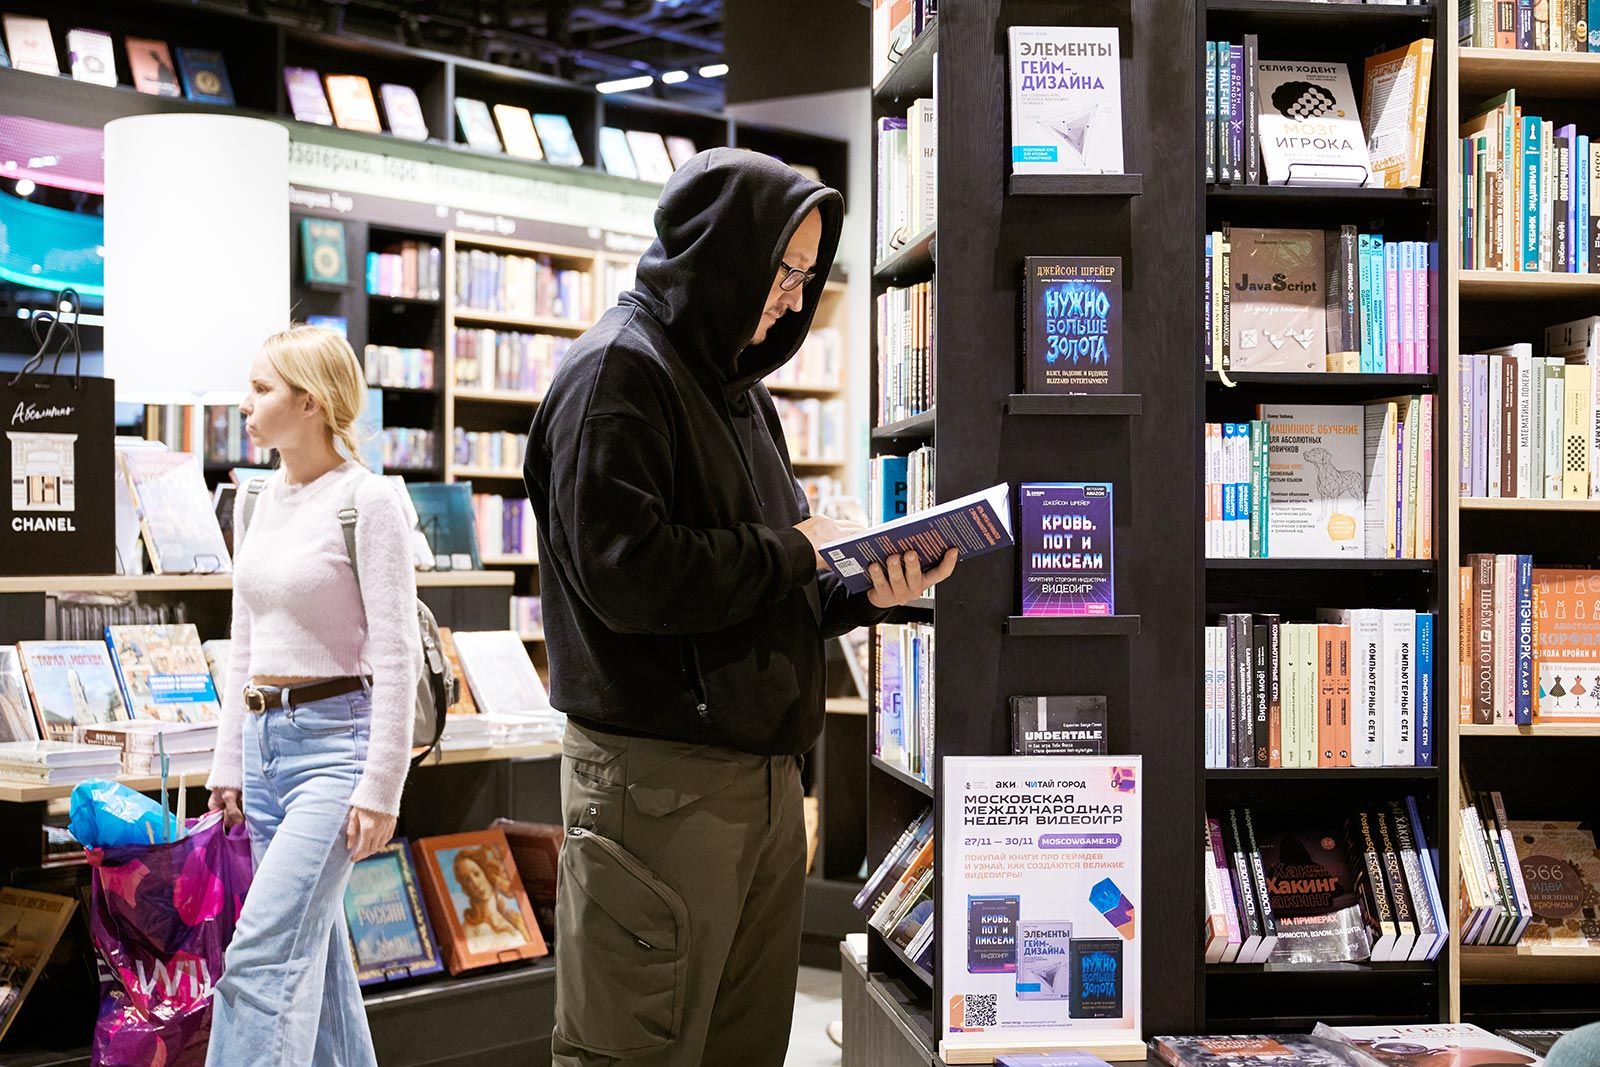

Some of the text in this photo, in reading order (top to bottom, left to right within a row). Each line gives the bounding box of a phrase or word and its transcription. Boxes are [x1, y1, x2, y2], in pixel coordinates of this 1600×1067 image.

[1020, 42, 1112, 57] ЭЛЕМЕНТЫ
[1021, 57, 1071, 75] ГЕЙМ-
[1258, 64, 1337, 75] СЕЛИЯ ХОДЕНТ
[1021, 72, 1105, 91] ДИЗАЙНА
[1206, 70, 1217, 115] HALF-LIFE
[1220, 70, 1231, 115] HALF-LIFE
[1283, 124, 1337, 136] МОЗГ
[1275, 137, 1353, 151] ИГРОКА
[1560, 148, 1569, 201] ОКОНЧАНИЯ
[1527, 165, 1538, 252] УЧЕБНИК ЭНДШПИЛЯ
[1036, 265, 1115, 277] ДЖЕЙСОН ШРЕЙЕР
[1235, 273, 1318, 293] JavaScript
[1044, 289, 1110, 318] НУЖНО
[1046, 318, 1108, 335] БОЛЬШЕ
[1045, 335, 1109, 366] ЗОЛОТА
[1521, 369, 1530, 447] МАТЕМАТИКА ПОКЕРА
[1317, 423, 1360, 436] ОБУЧЕНИЕ
[1410, 400, 1420, 465] КОМПЬЮТЕРНЫЙ
[1424, 400, 1433, 451] СМАРТФОН
[1281, 436, 1322, 445] АБСОЛЮТНЫХ
[1408, 467, 1417, 502] БУКВАРЬ
[12, 517, 76, 532] CHANEL
[1042, 515, 1097, 531] КРОВЬ,
[1043, 533, 1073, 550] ПОТ
[1031, 553, 1104, 569] ПИКСЕЛИ
[1041, 584, 1092, 594] ВИДЕОИГР
[1508, 577, 1516, 613] ФОРМУЛА
[1480, 589, 1493, 627] ШЬЁМ
[1508, 614, 1516, 663] ИДЕАЛЬНОГО
[1520, 600, 1532, 660] ПЭЧВОРК
[1272, 624, 1280, 681] КОМПЬЮТЕРНЫЕ
[1480, 644, 1491, 663] ПО
[1562, 648, 1589, 658] КРОЙКИ
[1257, 671, 1266, 692] моё!
[1368, 643, 1376, 716] КОМПЬЮТЕРНЫЕ
[1401, 643, 1409, 716] КОМПЬЮТЕРНЫЕ
[1480, 665, 1491, 705] ГОСТУ
[1216, 671, 1226, 710] ГОСУСЛУГИ
[1257, 693, 1266, 722] Вирьё
[1024, 731, 1103, 741] UNDERTALE
[1368, 720, 1376, 742] СЕТИ
[1401, 719, 1409, 742] СЕТИ
[995, 781, 1017, 792] аки
[1025, 778, 1054, 791] ЧИТАЙ
[1057, 781, 1087, 792] ГОРОД
[964, 795, 1074, 804] МОСКОВСКАЯ
[964, 805, 1122, 815] МЕЖДУНАРОДНАЯ
[964, 815, 1122, 826] НЕДЕЛЯ ВИДЕОИГР
[964, 837, 1119, 847] 27/11 30/11 MOSCOWGAME.RU
[965, 852, 1103, 862] ПОКУПАЙ КНИГИ ПРО ГЕЙМДЕВ
[974, 862, 1005, 873] УЗНАЙ,
[1008, 863, 1025, 871] КАК
[1027, 863, 1081, 871] СОЗДАЮТСЯ
[1083, 861, 1125, 870] ВЕЛИКИЕ
[1523, 864, 1564, 881] 366
[965, 872, 1023, 881] ВИДЕОИГРЫ!
[1238, 859, 1256, 916] БЕЗОПАСНОСТЬ
[1254, 859, 1272, 916] БЕЗОПАСНОСТЬ
[1266, 877, 1339, 895] Хакинг
[1533, 882, 1564, 893] идей
[1375, 883, 1391, 920] PL/pgSQL
[1393, 883, 1409, 920] PL/pgSQL
[1533, 901, 1574, 910] крючком
[1281, 914, 1339, 926] НА ПРИМЕРАХ
[981, 925, 998, 935] ПОТ
[1024, 930, 1070, 939] ЭЛЕМЕНТЫ
[975, 936, 1015, 946] ПИКСЕЛИ
[1024, 939, 1050, 948] ГЕЙМ-
[1024, 947, 1066, 958] ДИЗАЙНА
[1081, 956, 1116, 975] НУЖНО
[1082, 974, 1115, 984] БОЛЬШЕ
[1082, 983, 1116, 998] ЗОЛОТА
